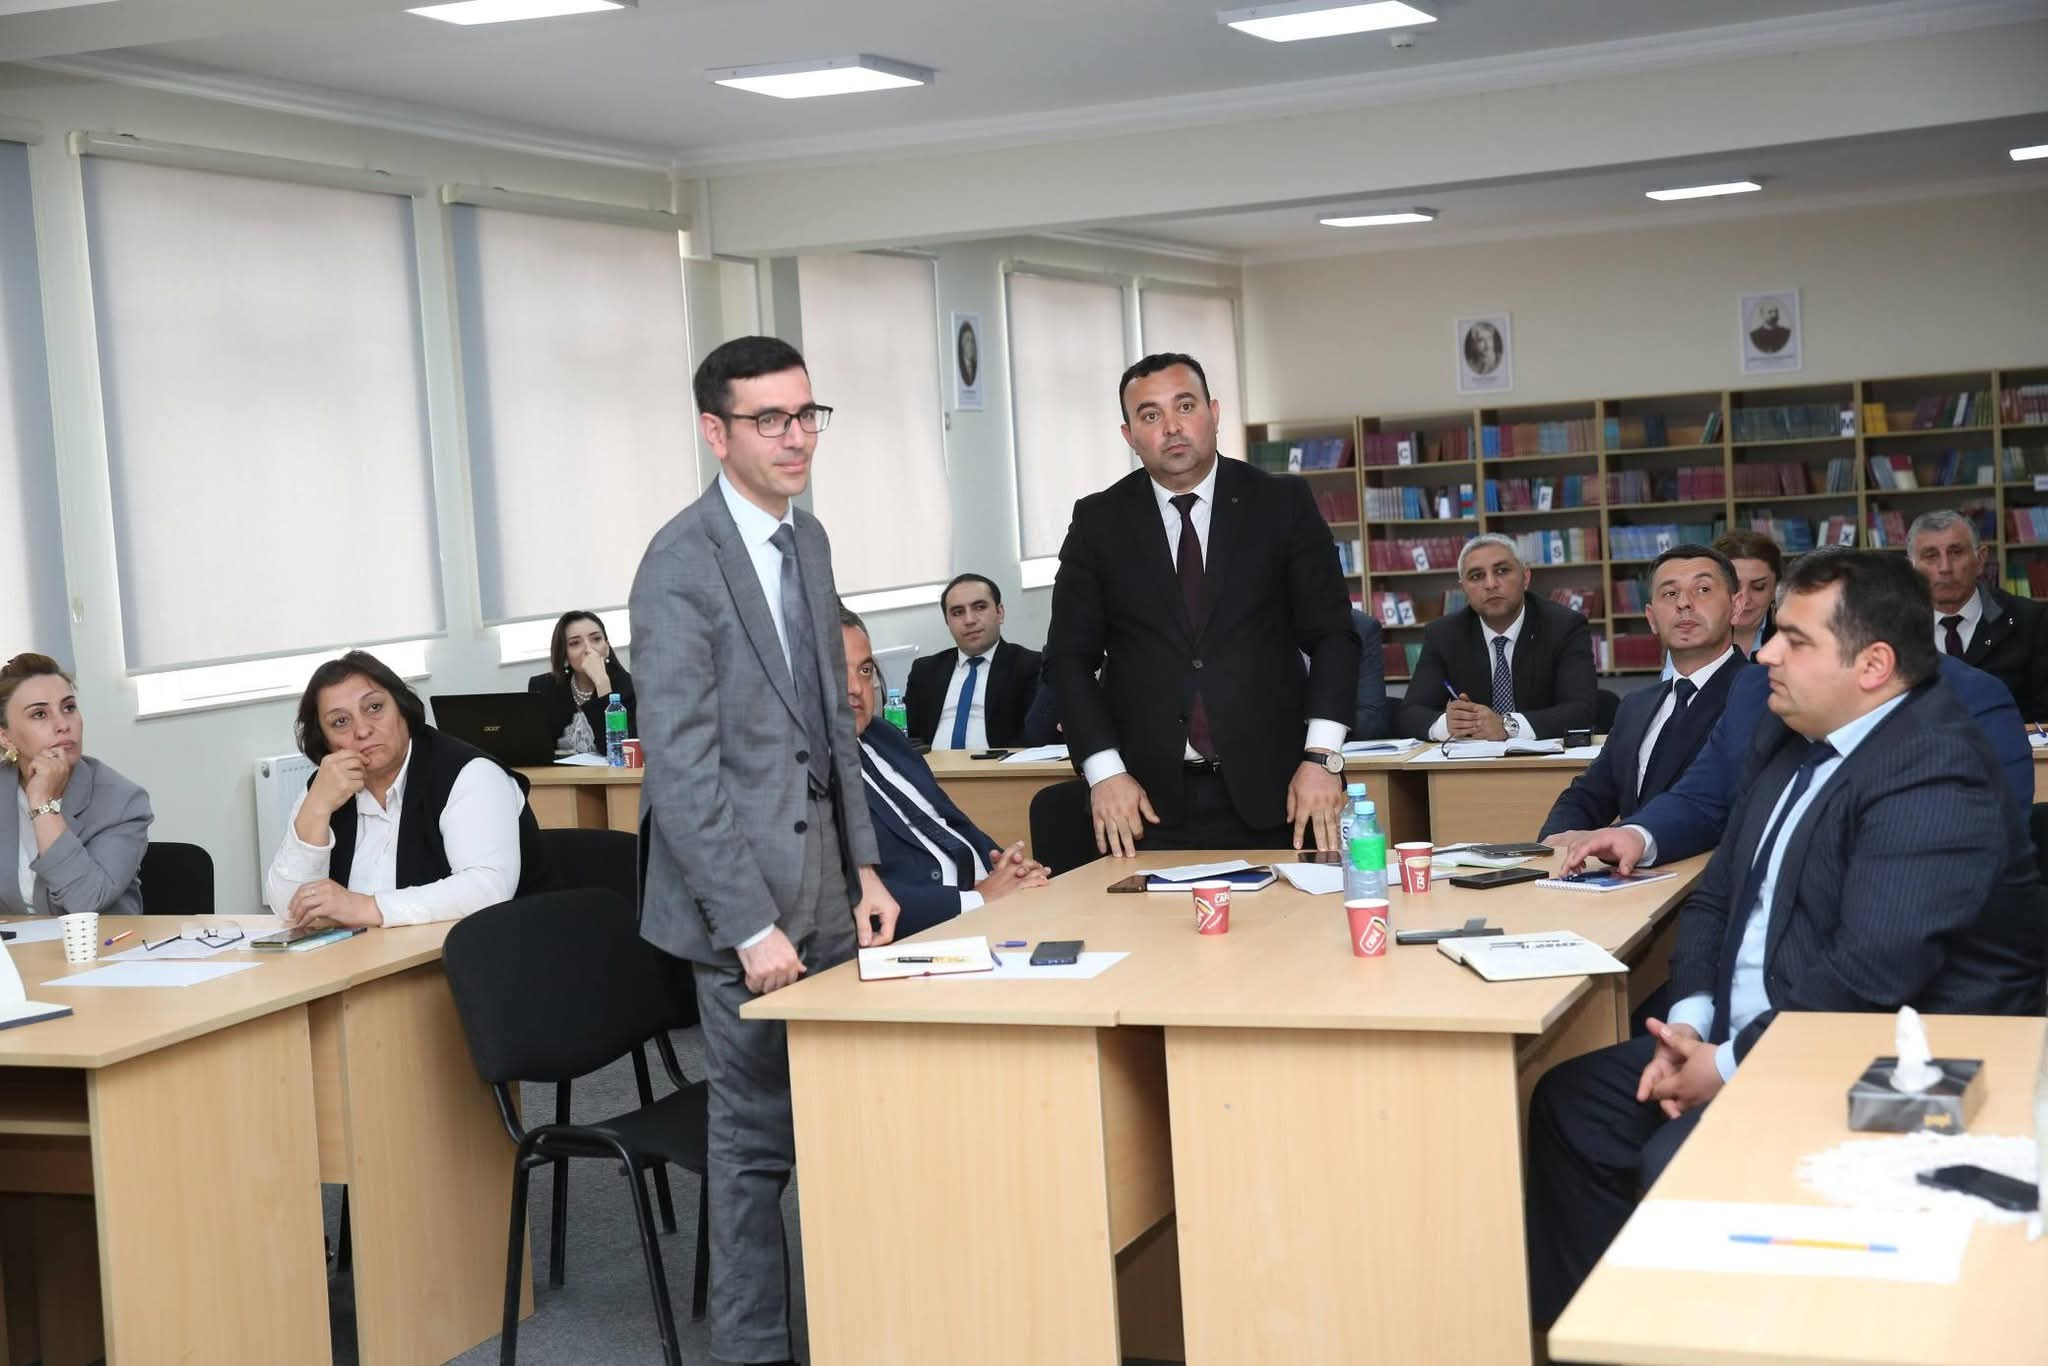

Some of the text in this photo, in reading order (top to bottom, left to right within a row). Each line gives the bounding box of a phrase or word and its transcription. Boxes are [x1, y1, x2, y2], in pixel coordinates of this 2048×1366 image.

[1399, 447, 1409, 460] C
[1289, 455, 1299, 467] A
[1541, 491, 1550, 505] F
[1553, 545, 1562, 559] S
